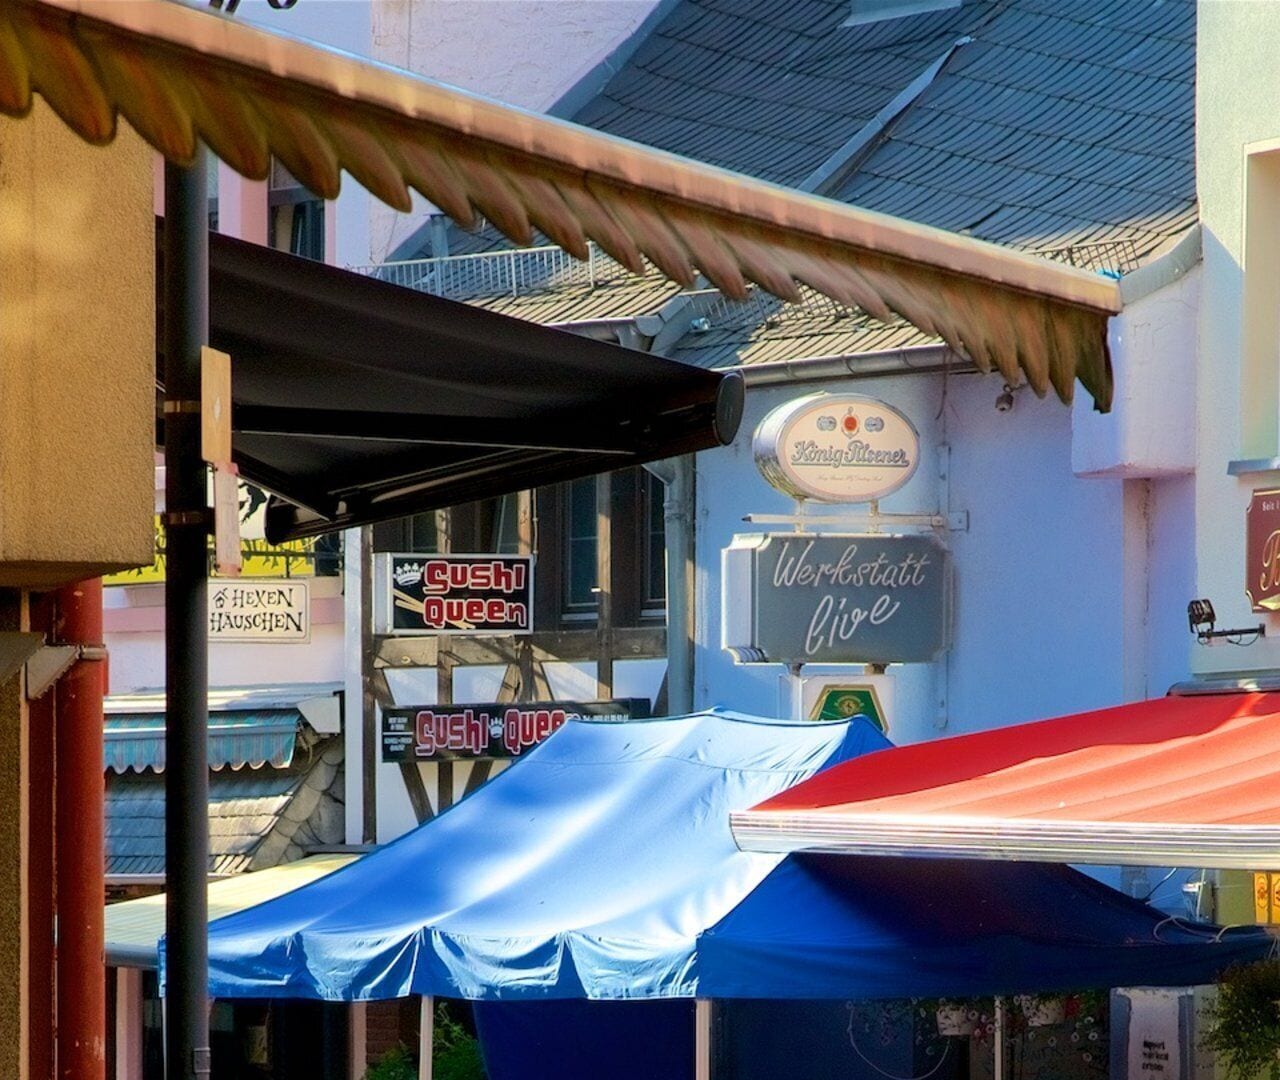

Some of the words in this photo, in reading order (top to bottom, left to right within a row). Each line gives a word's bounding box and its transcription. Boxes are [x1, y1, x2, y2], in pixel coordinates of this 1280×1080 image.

[423, 560, 526, 594] Sushi
[773, 539, 931, 588] Werkstatt
[232, 588, 294, 609] HEXEN
[424, 596, 527, 628] Queen
[210, 611, 303, 633] HÄUSCHEN
[415, 709, 489, 756] Sushi
[503, 708, 580, 755] Quee
